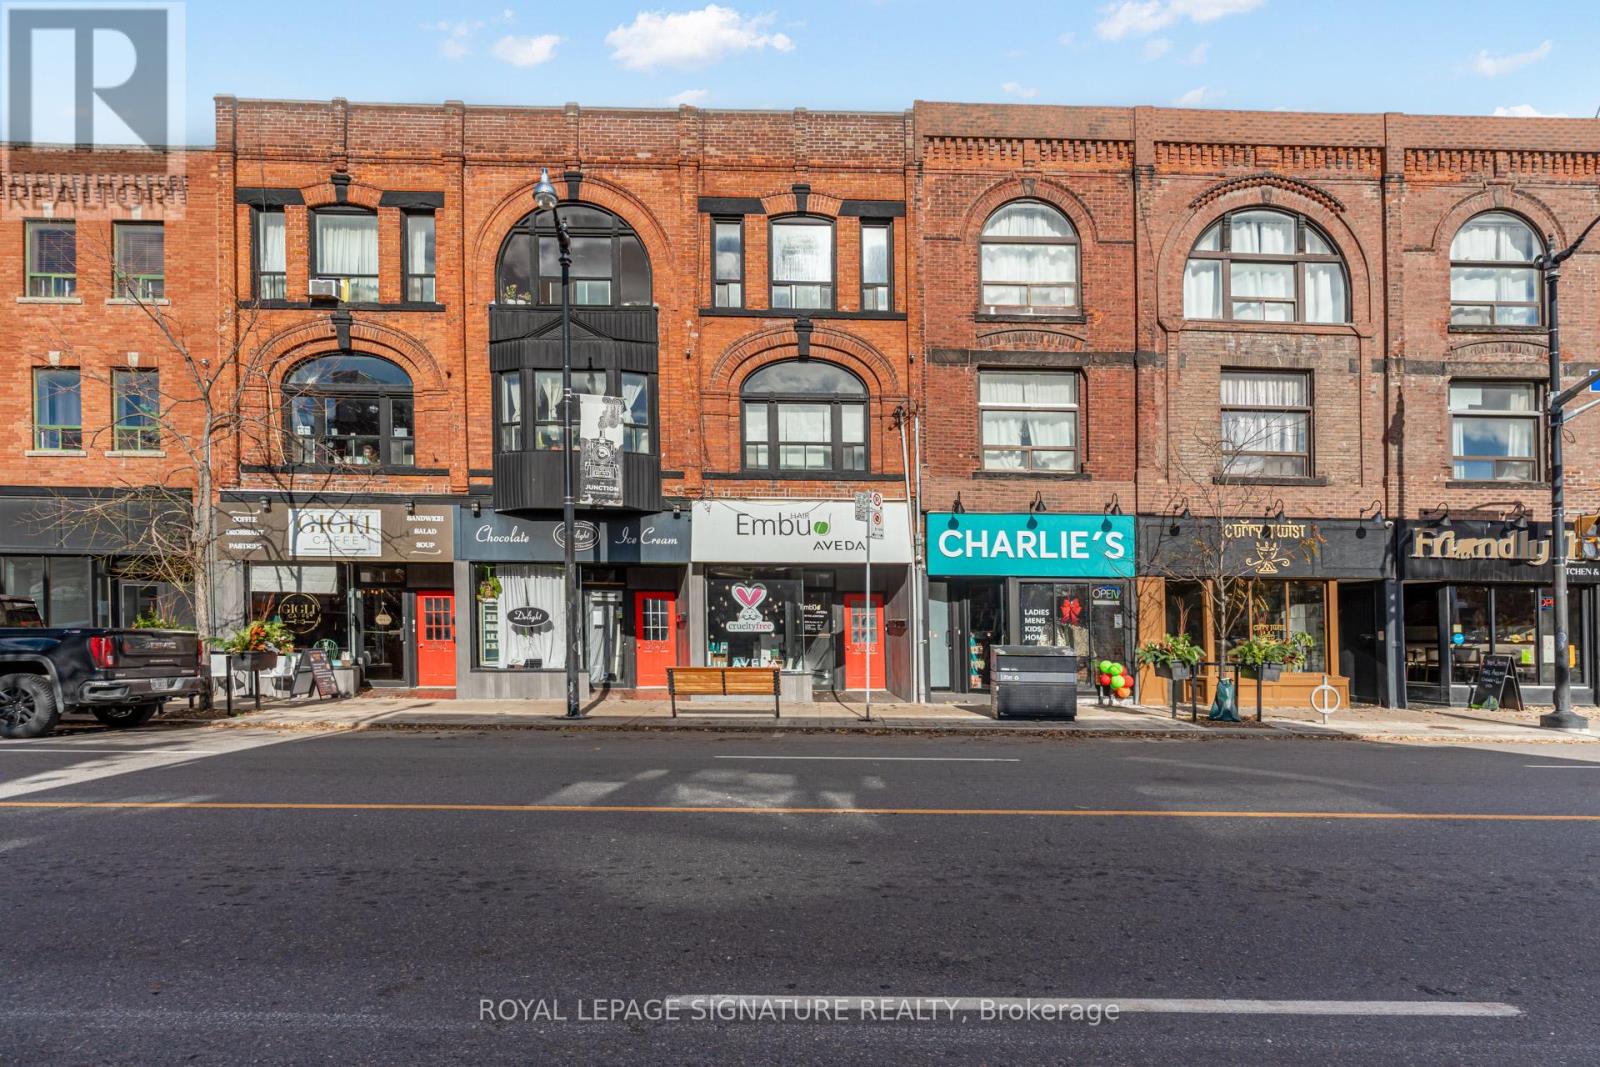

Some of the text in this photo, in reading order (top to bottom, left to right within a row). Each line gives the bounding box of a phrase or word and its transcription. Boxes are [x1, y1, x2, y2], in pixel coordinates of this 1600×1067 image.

[790, 512, 810, 520] HAIR
[475, 524, 530, 543] Chocolate
[614, 526, 679, 544] Ice Cream
[813, 540, 866, 551] AVEDA
[938, 529, 1126, 560] CHARLIE'S
[1409, 527, 1550, 565] Frindly
[1566, 567, 1593, 576] TCHEN
[1092, 588, 1121, 599] OPEN
[513, 610, 542, 623] Delight
